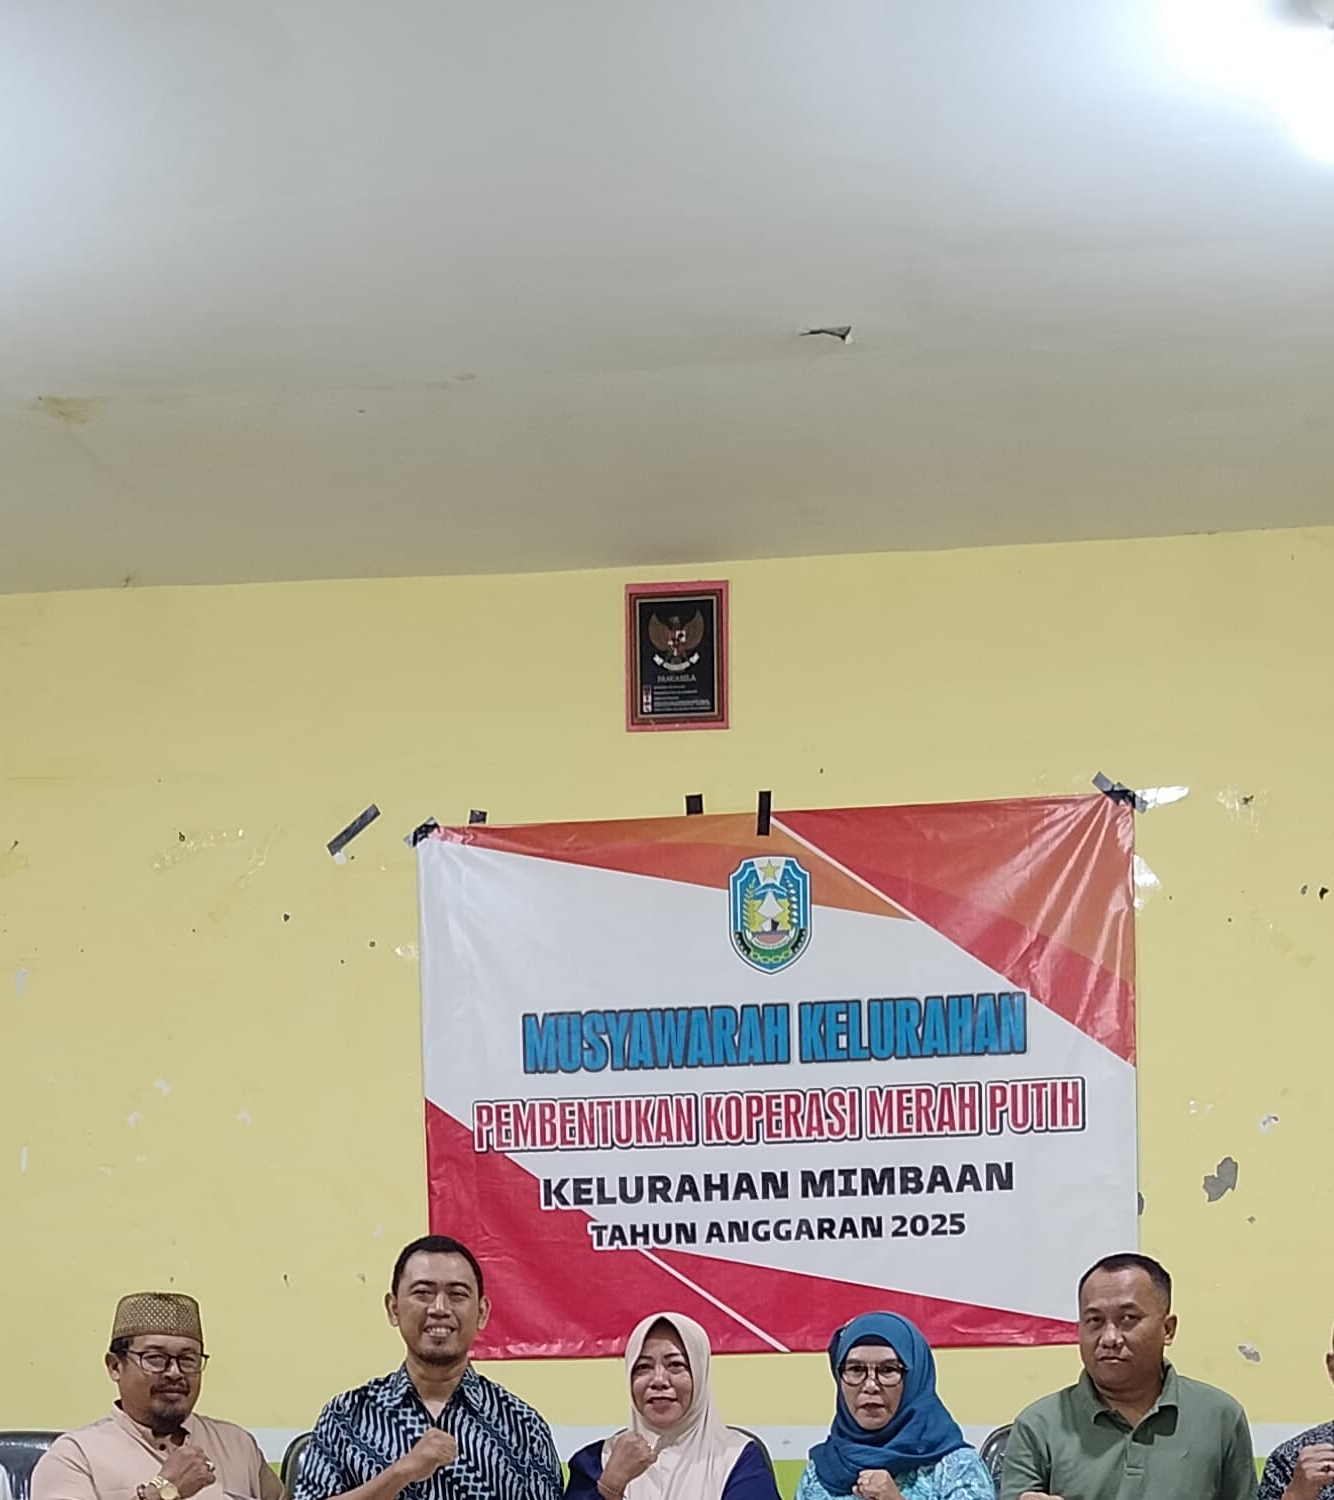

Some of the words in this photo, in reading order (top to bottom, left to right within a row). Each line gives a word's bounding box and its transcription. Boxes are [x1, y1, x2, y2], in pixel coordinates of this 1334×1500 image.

[522, 1003, 791, 1073] MUSYAWARAH
[799, 992, 1027, 1063] KELURAHAN
[473, 1092, 698, 1152] PEMBENTUKAN
[703, 1086, 861, 1146] KOPERASI
[866, 1082, 982, 1139] MERAH
[987, 1077, 1085, 1135] PUTIH
[542, 1172, 789, 1208] KELURAHAN
[800, 1161, 1015, 1198] MIMBAAN
[591, 1221, 699, 1249] TAHUN
[705, 1216, 884, 1243] ANGGARAN
[891, 1212, 967, 1238] 2025
